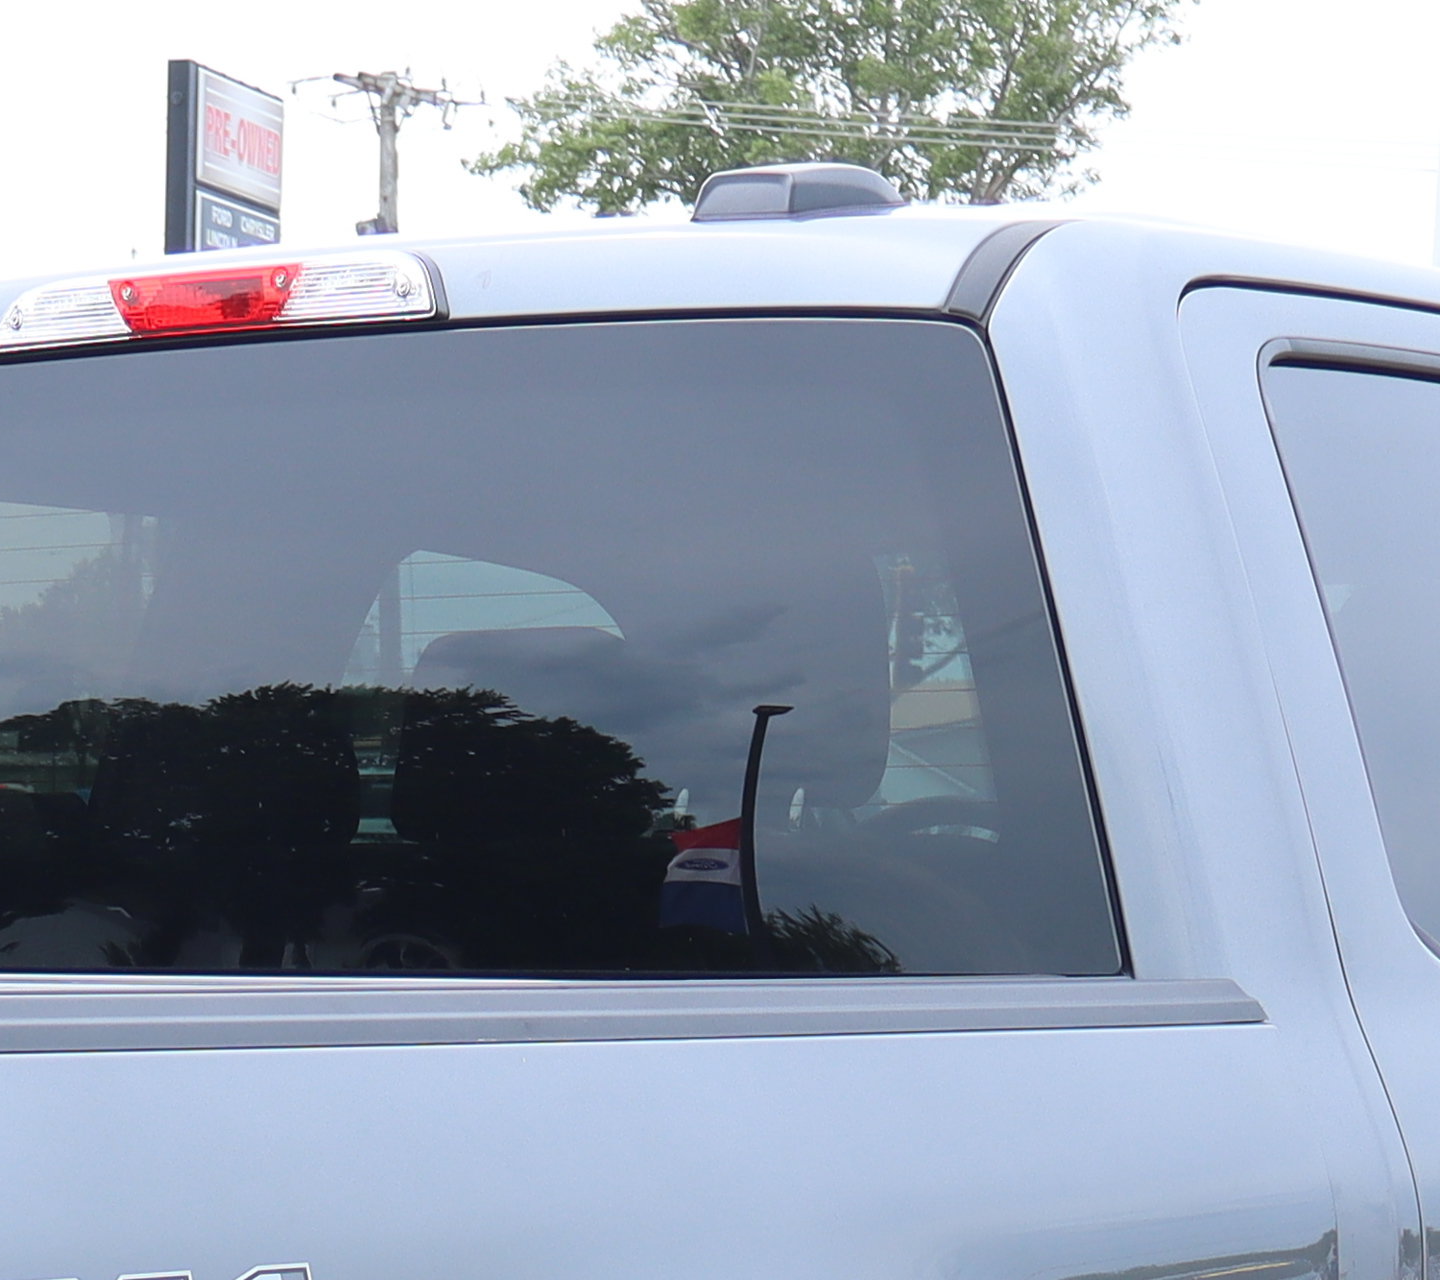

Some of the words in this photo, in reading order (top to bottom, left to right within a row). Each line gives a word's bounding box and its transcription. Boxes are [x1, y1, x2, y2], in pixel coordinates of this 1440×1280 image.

[206, 104, 281, 176] PRE-OWNED
[211, 205, 233, 229] FORD
[240, 215, 275, 242] CHRYSLER
